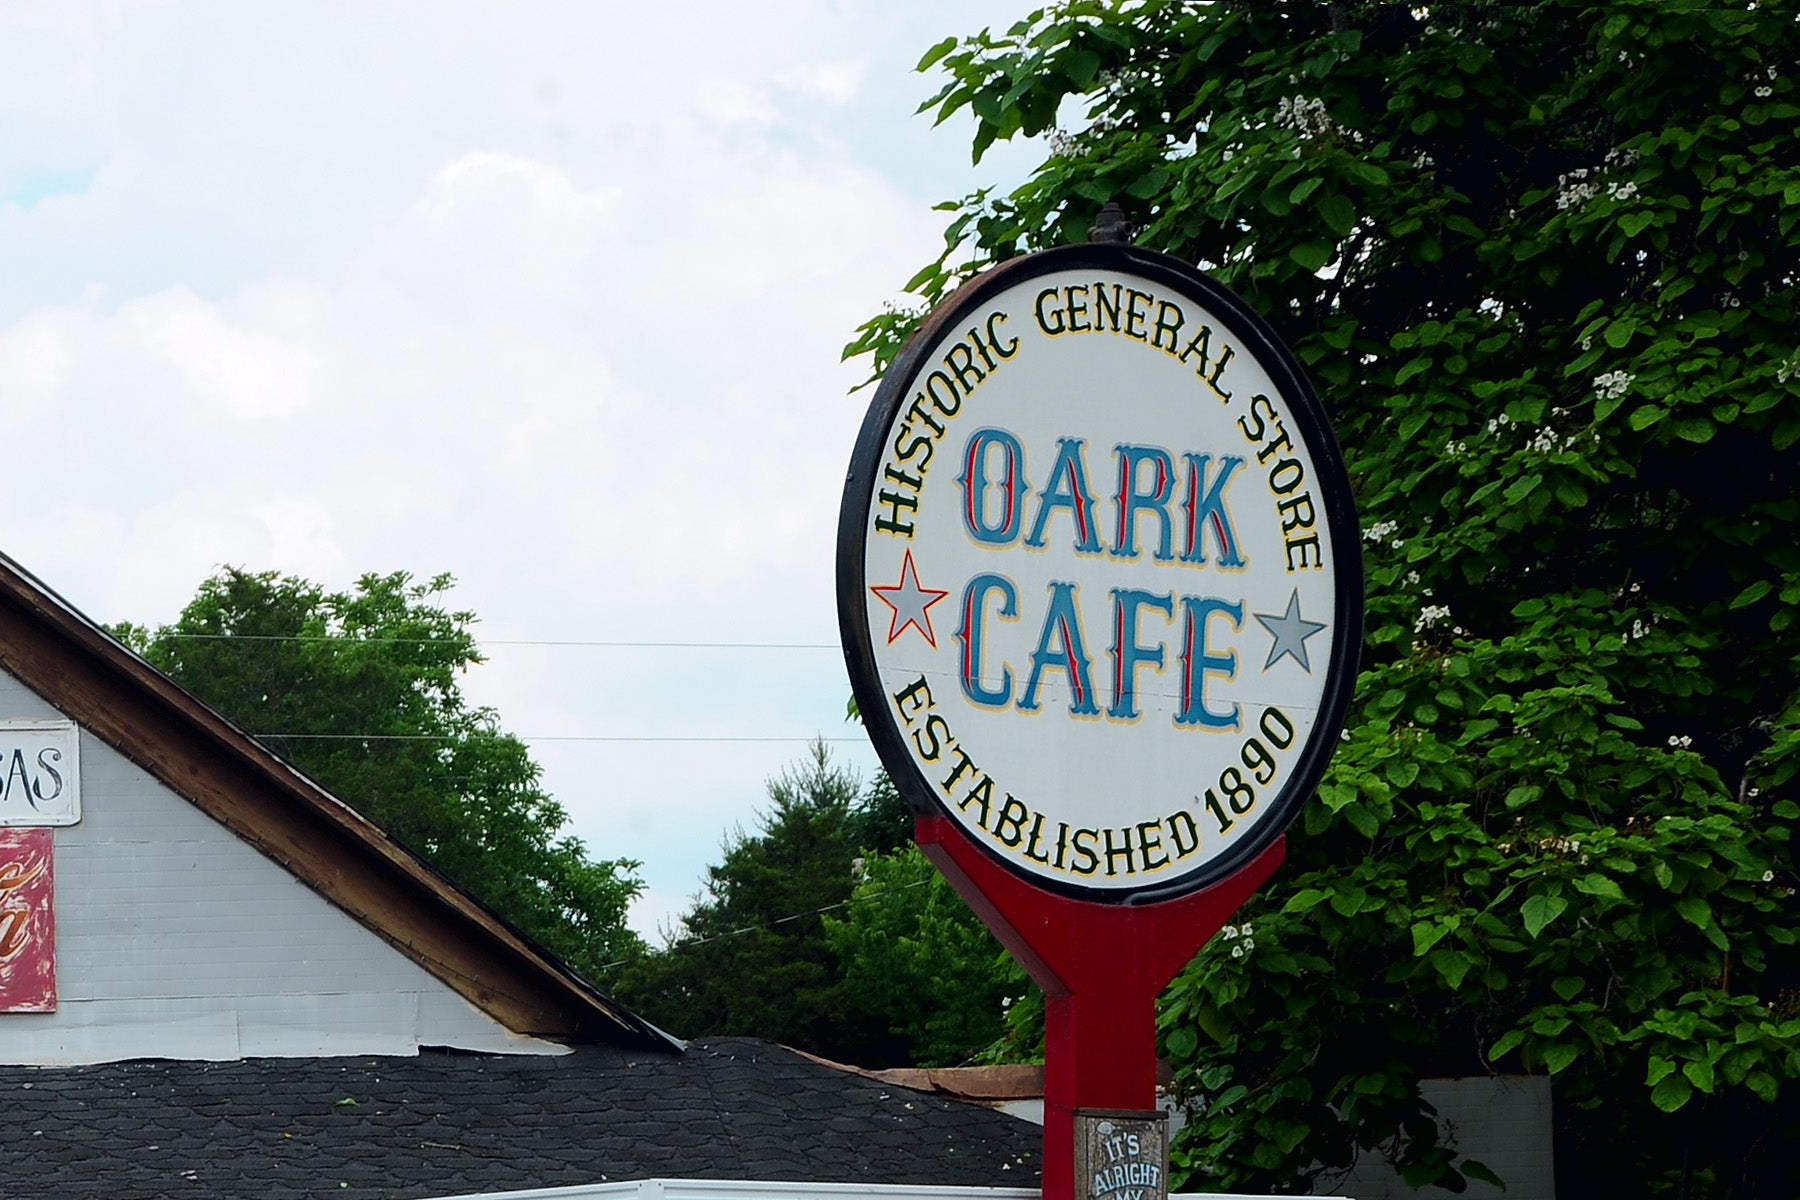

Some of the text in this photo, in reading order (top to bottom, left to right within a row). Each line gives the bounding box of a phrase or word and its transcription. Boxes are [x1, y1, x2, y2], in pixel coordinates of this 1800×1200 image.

[874, 282, 1323, 573] HISTORIC GENERAL STORE
[955, 427, 1248, 569] OARK
[954, 573, 1246, 732] CAFE
[893, 675, 1296, 878] ESTABLISHED 1890
[1093, 1162, 1161, 1197] ALRIGHT
[1105, 1132, 1140, 1162] IT'S
